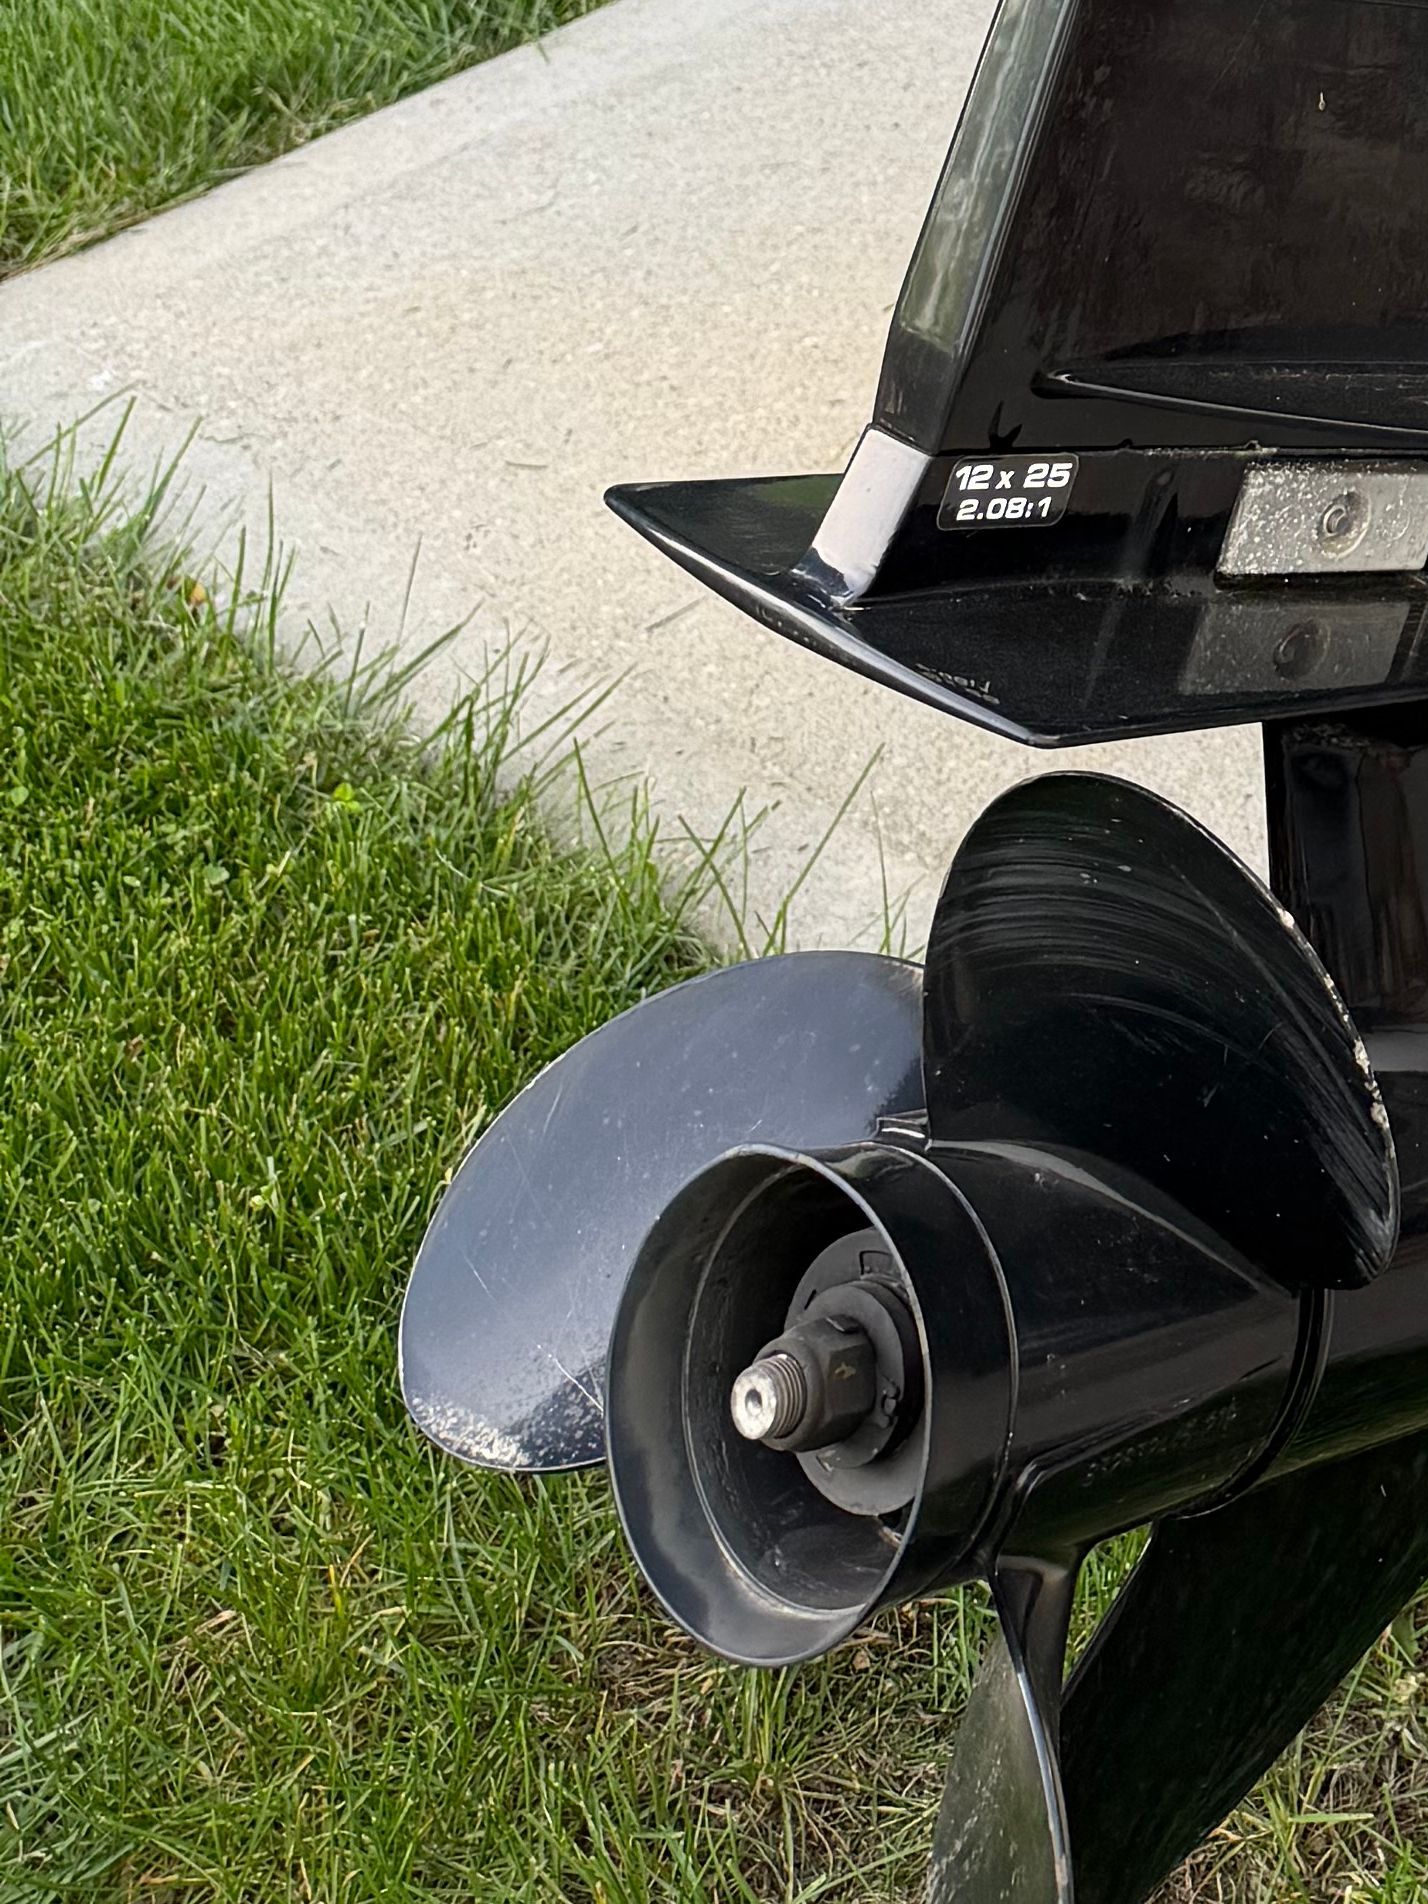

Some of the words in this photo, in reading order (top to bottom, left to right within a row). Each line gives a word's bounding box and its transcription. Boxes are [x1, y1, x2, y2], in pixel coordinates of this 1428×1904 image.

[955, 463, 994, 491] 12
[994, 470, 1015, 490] x
[1022, 462, 1073, 488] 25
[955, 495, 1053, 521] 2.08:1
